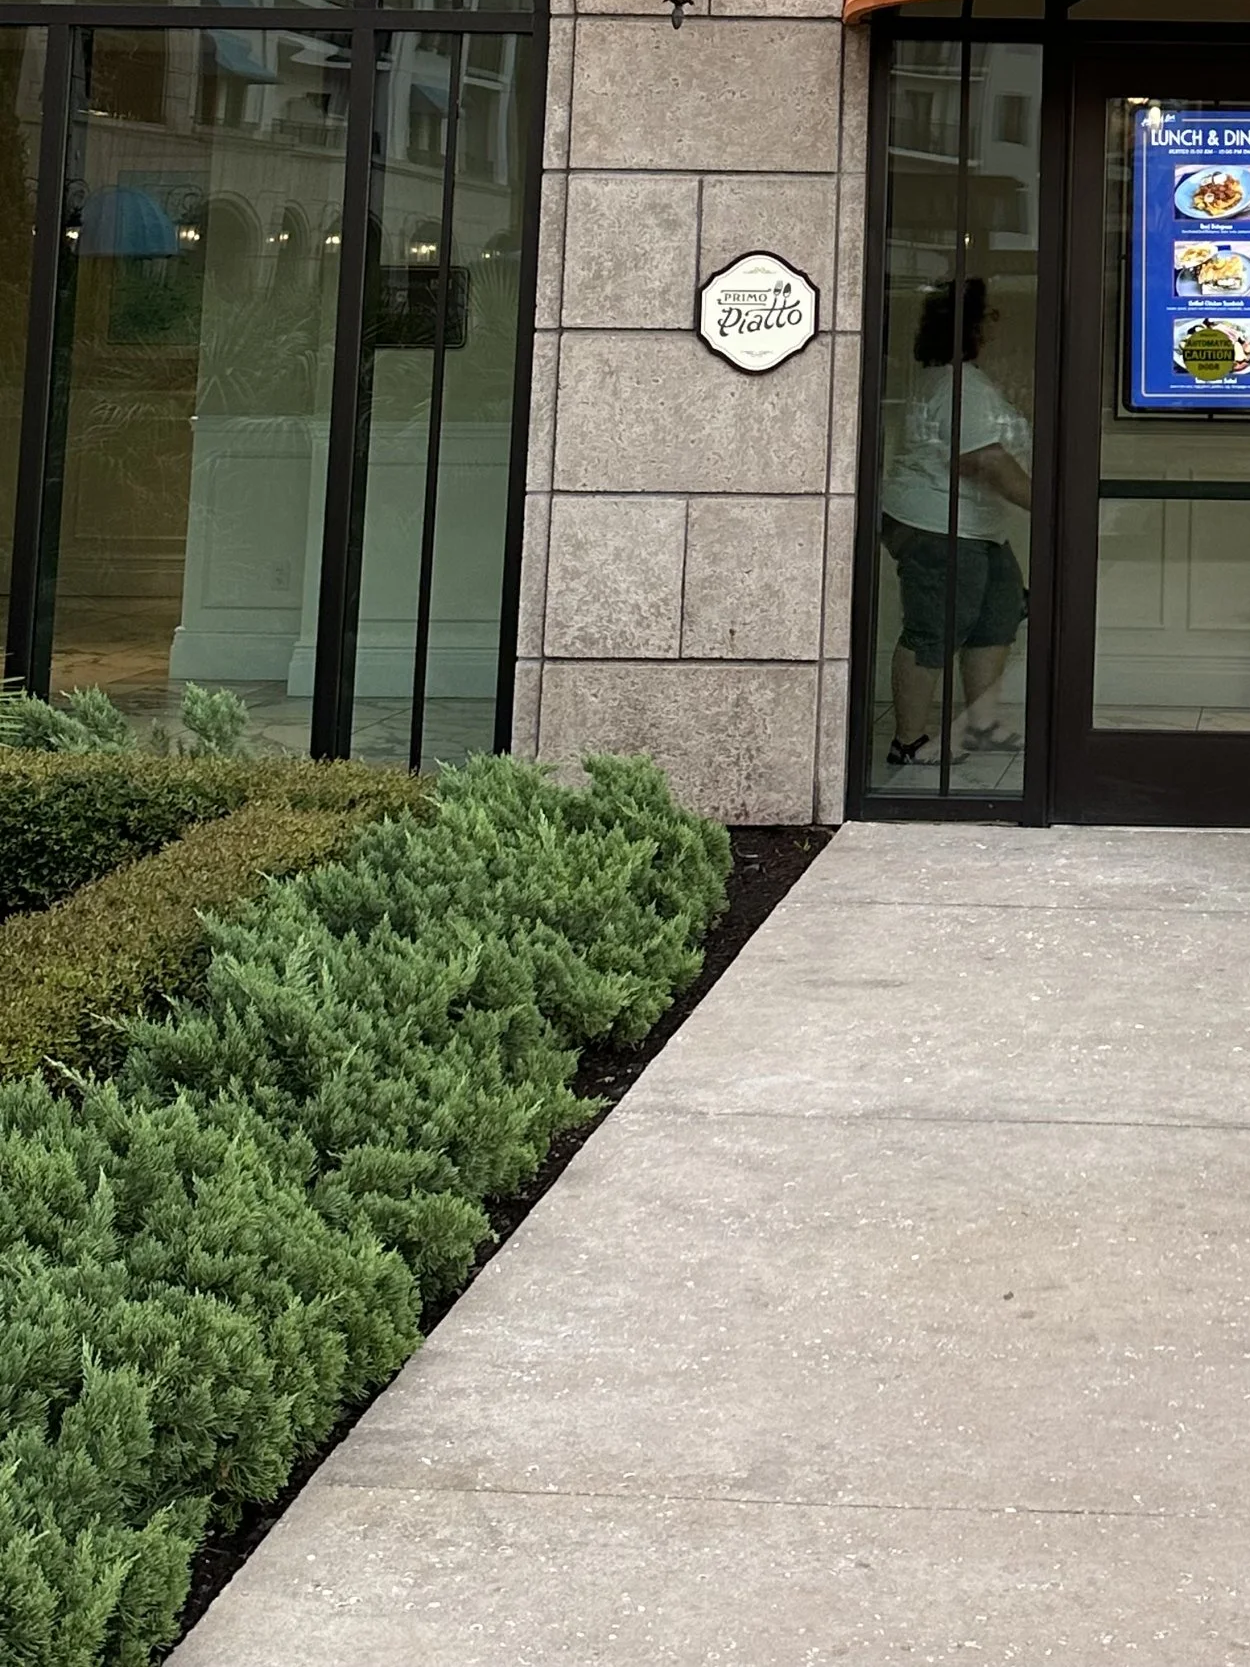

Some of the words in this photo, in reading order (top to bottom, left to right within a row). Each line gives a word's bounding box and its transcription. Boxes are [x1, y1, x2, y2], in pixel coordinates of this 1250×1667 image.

[1151, 129, 1202, 146] LUNCH
[1207, 129, 1219, 146] &
[724, 293, 767, 302] PRIMO
[717, 292, 803, 337] Piatto
[1184, 350, 1232, 360] CAUTION
